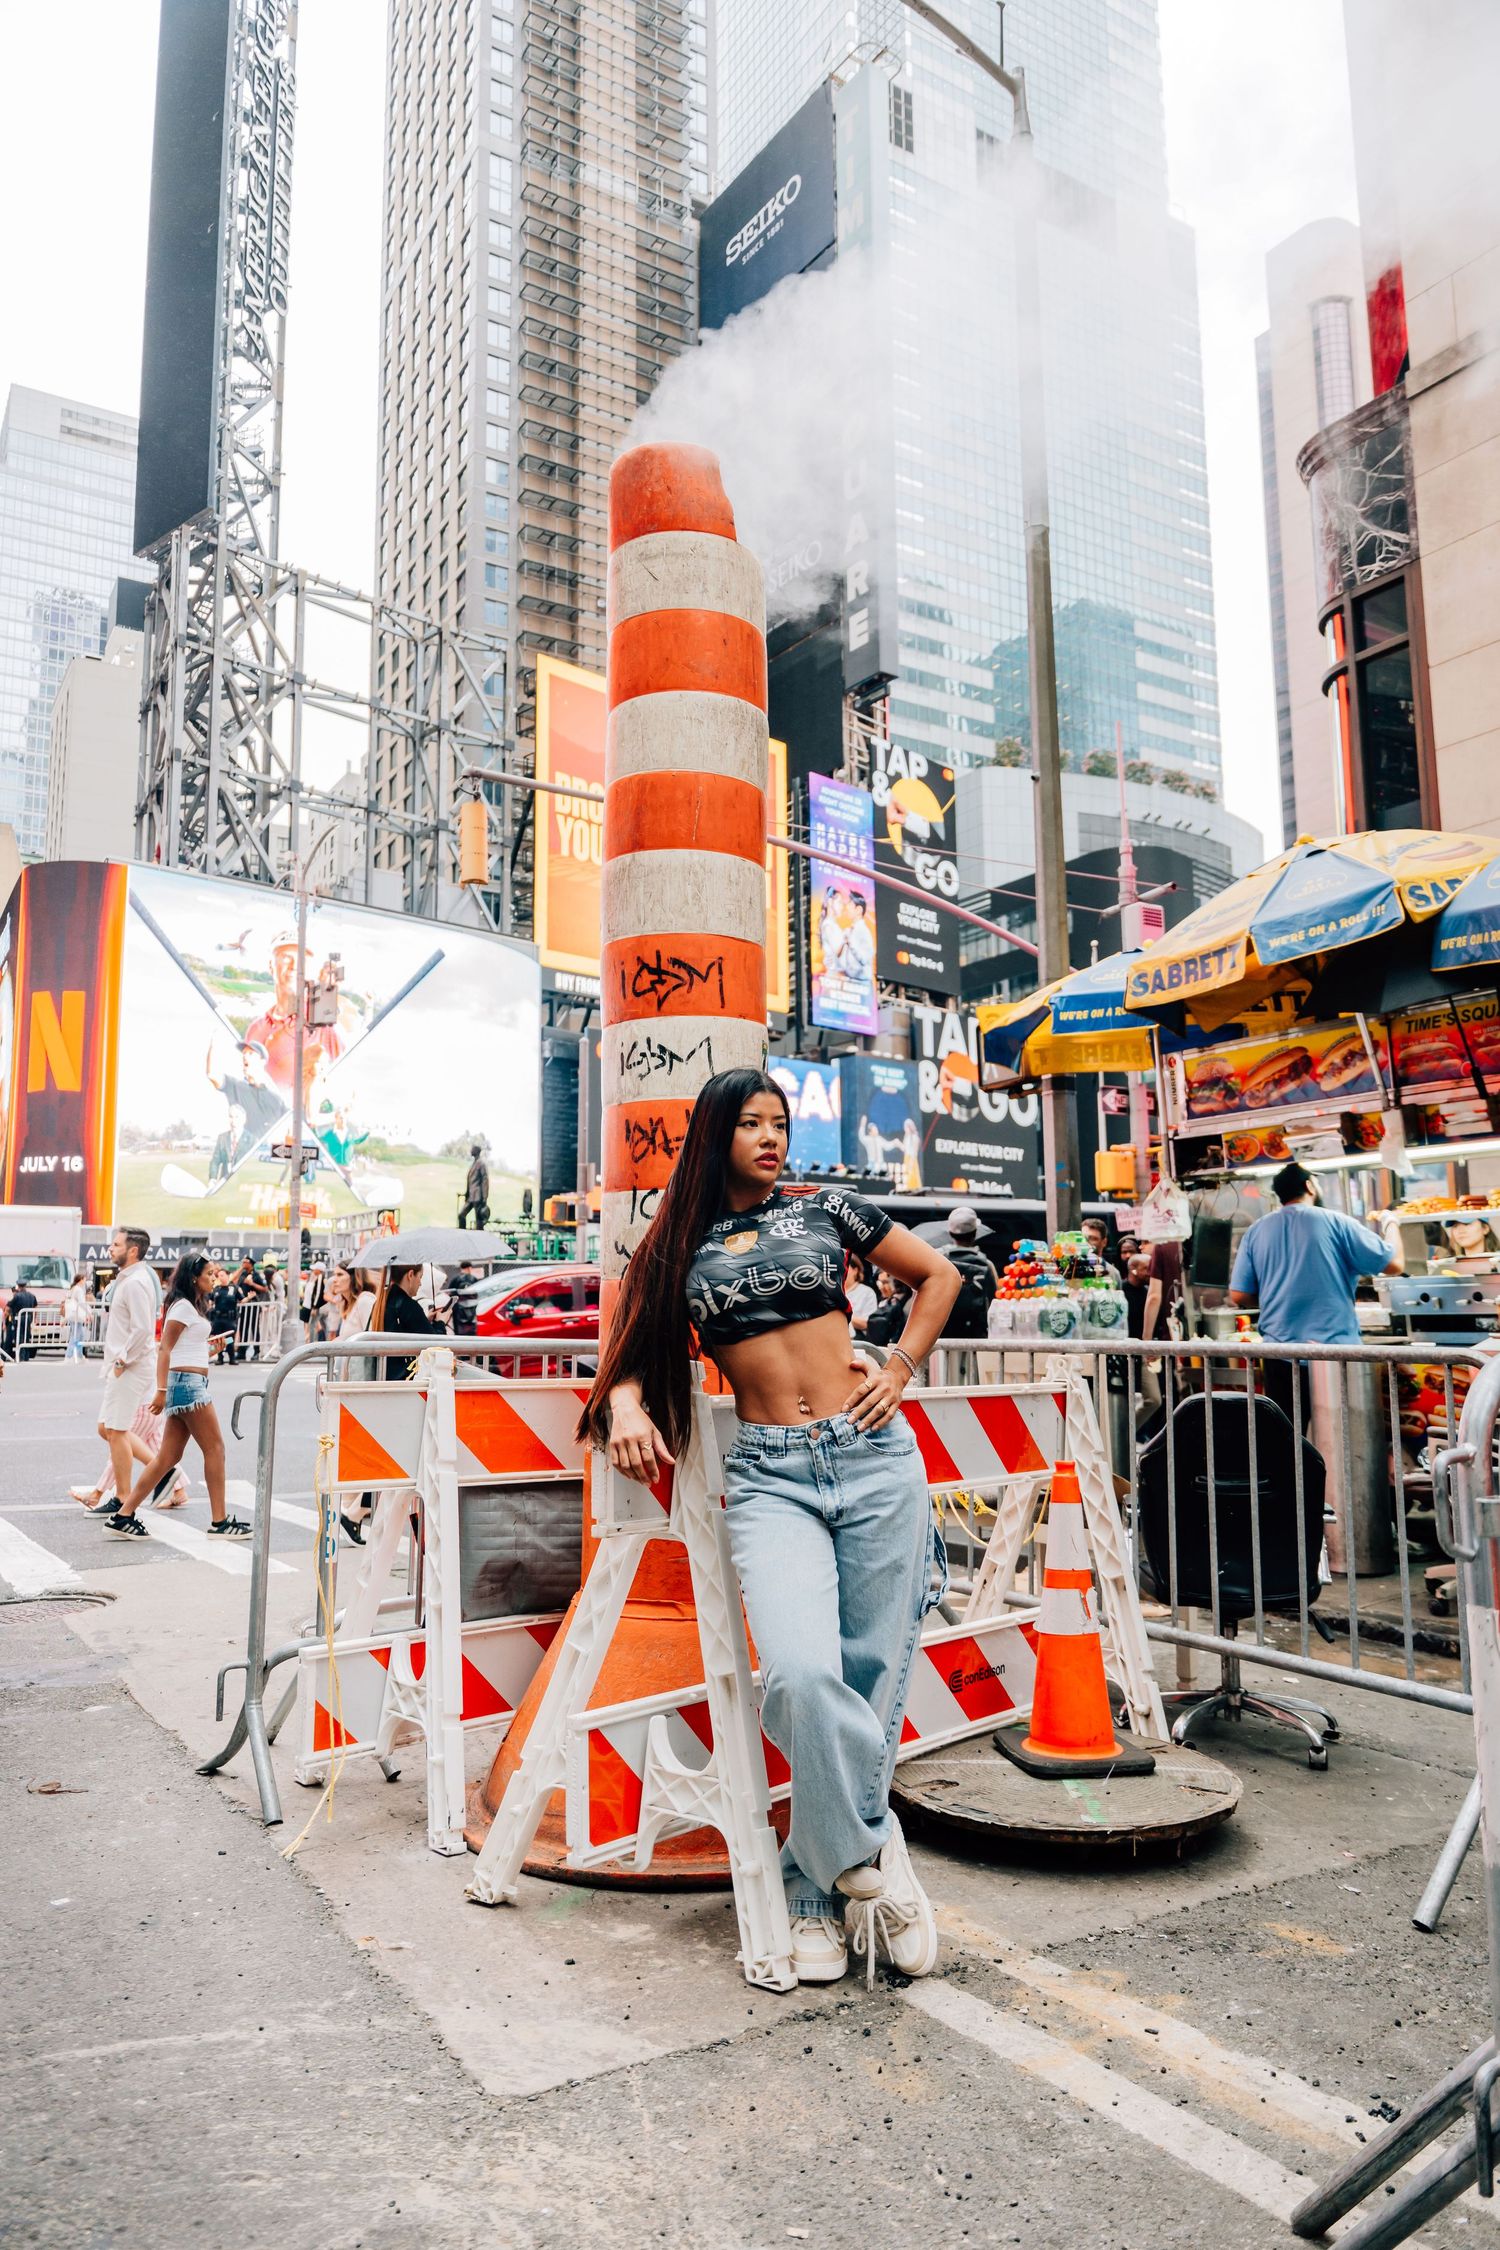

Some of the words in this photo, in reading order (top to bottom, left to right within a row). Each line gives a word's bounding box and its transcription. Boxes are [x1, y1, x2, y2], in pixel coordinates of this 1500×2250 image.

[726, 174, 802, 266] SEIKO
[742, 237, 765, 266] SINCE
[767, 540, 823, 594] SEIKO
[871, 735, 929, 780] TAP
[872, 770, 892, 807] &
[914, 853, 960, 897] GO
[1268, 929, 1306, 948] WE'RE
[1308, 923, 1326, 938] ON
[1328, 921, 1337, 932] A
[1339, 911, 1369, 929] ROLL
[1131, 943, 1238, 998] SABRETT
[1060, 1008, 1088, 1021] WE'RE
[1090, 1007, 1105, 1019] ON
[1106, 1007, 1113, 1018] A
[1405, 1013, 1456, 1034] TIME'S
[19, 1155, 59, 1174] JULY
[61, 1155, 84, 1172] 16
[935, 1138, 979, 1158] EXPLORE
[978, 1143, 1004, 1160] YOUR
[1003, 1147, 1025, 1162] CITY
[839, 1205, 875, 1242] kwai
[963, 1663, 1006, 1686] conEdison
